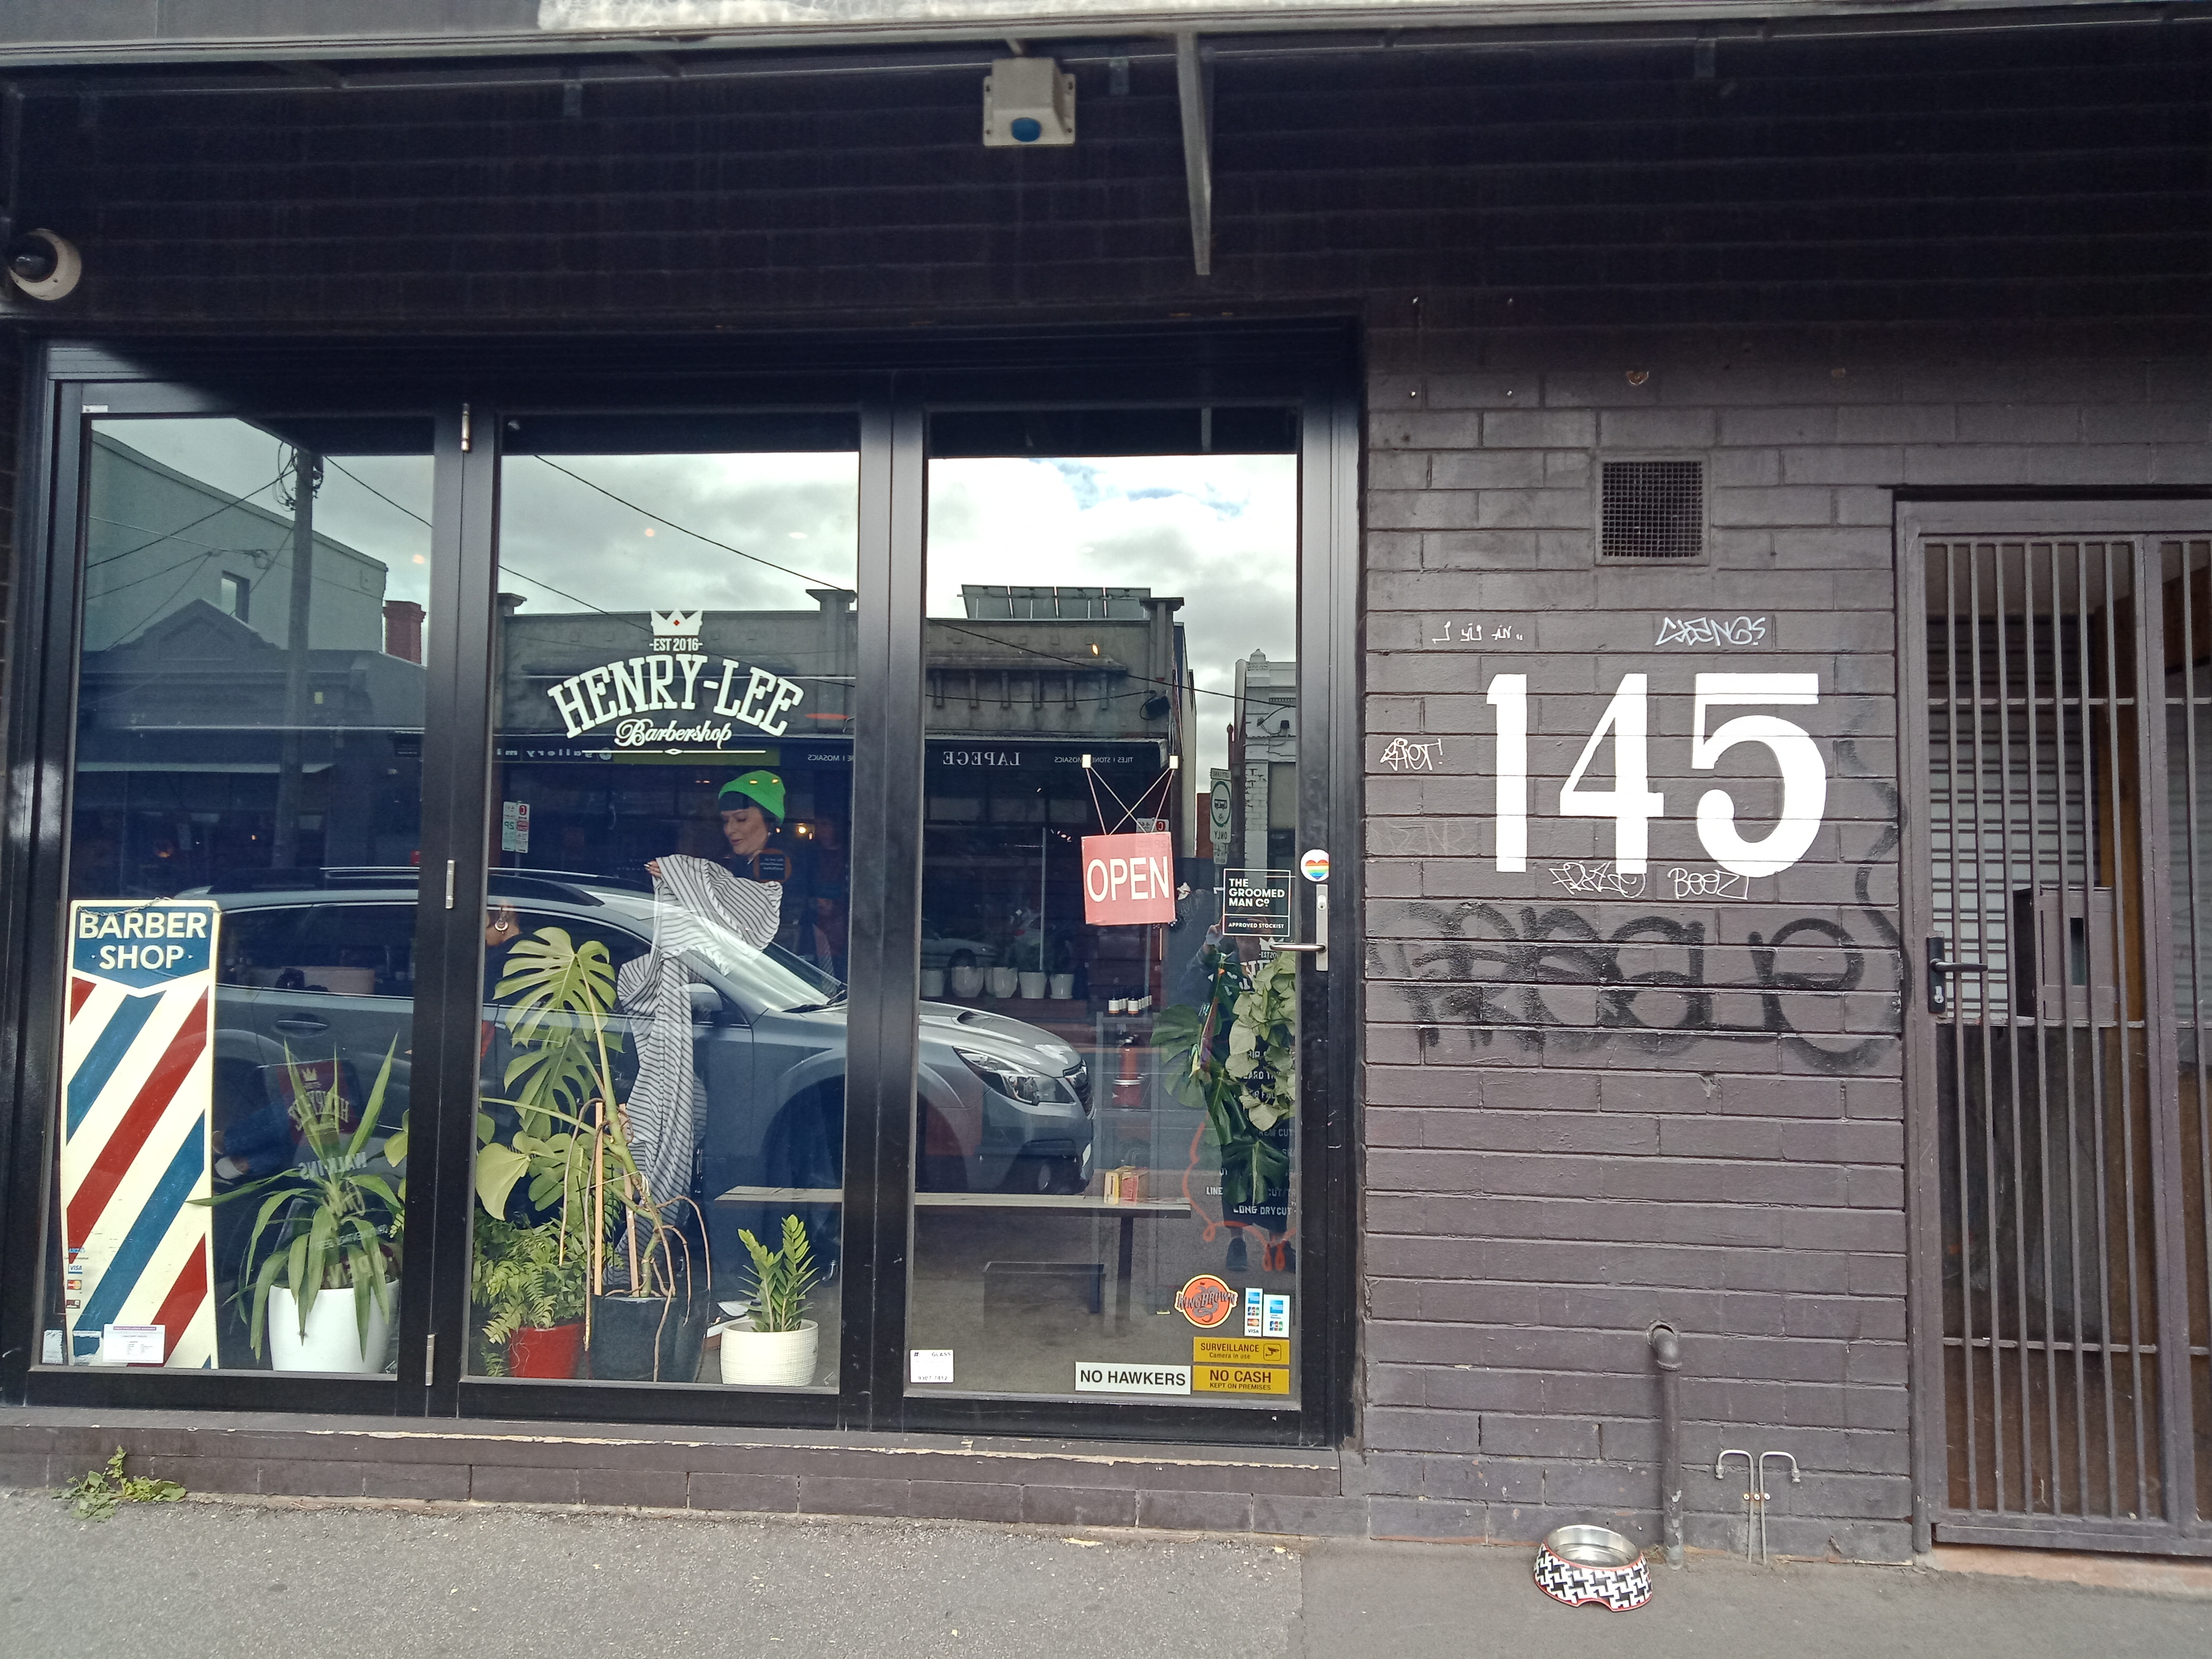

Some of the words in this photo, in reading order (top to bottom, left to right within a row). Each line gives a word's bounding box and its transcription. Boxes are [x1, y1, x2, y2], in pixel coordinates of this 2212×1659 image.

[547, 654, 805, 739] HENRY-LEE
[614, 718, 732, 749] Barbershop
[1486, 673, 1827, 878] 145
[1086, 856, 1170, 903] OPEN
[1228, 878, 1249, 887] THE
[1228, 887, 1285, 898] GROOMED
[1228, 898, 1253, 907] MAN
[79, 912, 207, 939] BARBER
[99, 945, 184, 969] SHOP
[1201, 1343, 1259, 1352] SURVEILLANCE
[1080, 1369, 1103, 1384] NO
[1107, 1370, 1186, 1387] HAWKERS
[1210, 1370, 1229, 1381] NO
[1234, 1370, 1272, 1384] CASH
